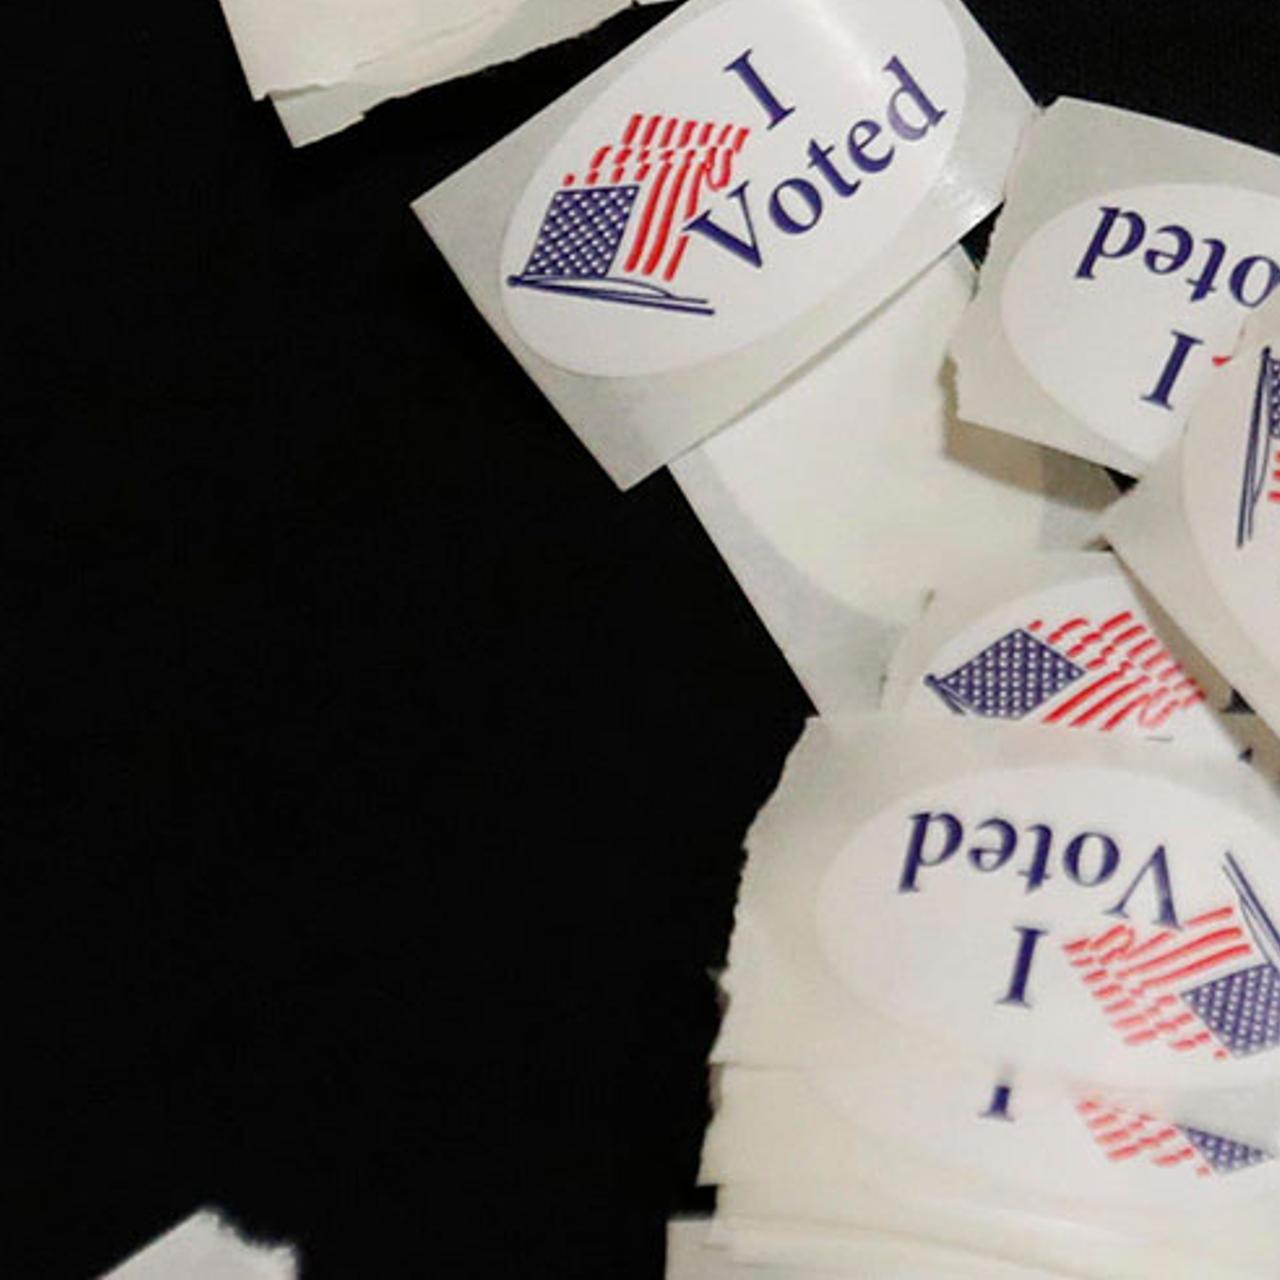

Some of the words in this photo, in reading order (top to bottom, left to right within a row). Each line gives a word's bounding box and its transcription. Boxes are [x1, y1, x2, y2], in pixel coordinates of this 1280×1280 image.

[722, 47, 796, 132] I
[681, 54, 948, 270] Voted
[1140, 329, 1206, 412] I
[896, 809, 1186, 933] Voted
[993, 923, 1051, 1012] I
